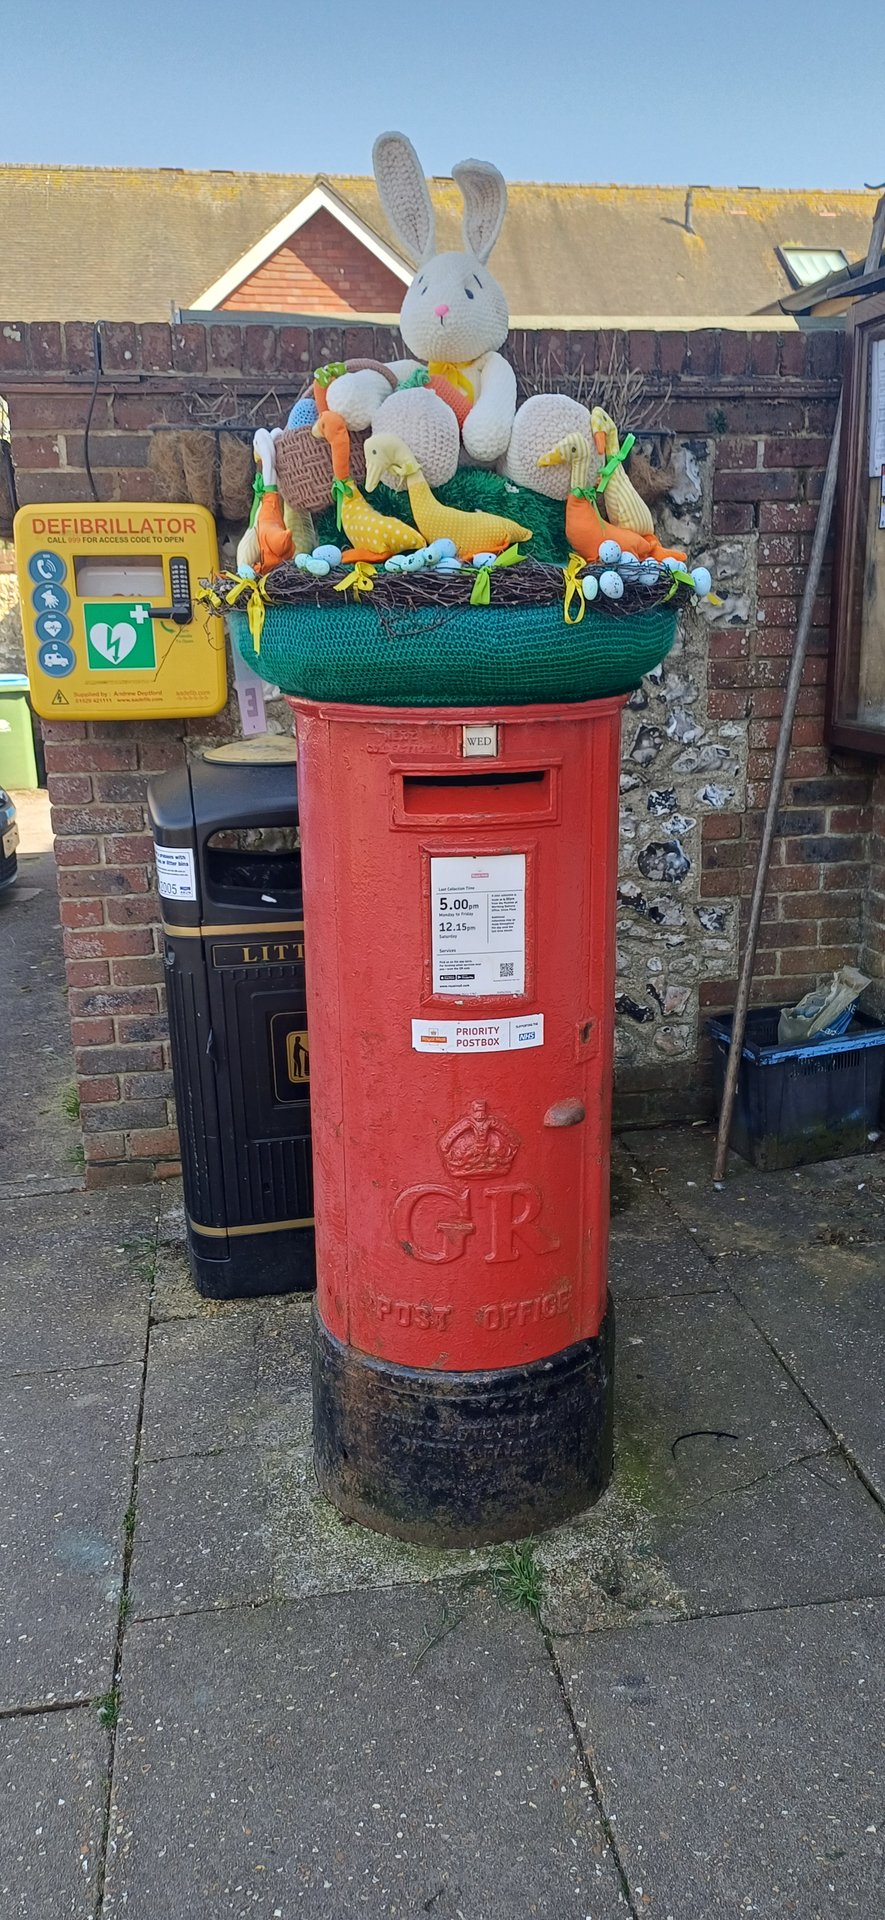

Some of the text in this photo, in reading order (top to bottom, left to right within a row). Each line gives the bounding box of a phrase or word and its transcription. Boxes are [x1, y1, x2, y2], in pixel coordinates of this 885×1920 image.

[32, 518, 196, 534] DEFIBRILLATOR
[467, 736, 492, 747] WED
[439, 897, 479, 911] 5.00pm
[439, 922, 476, 932] 12.15pm
[456, 1026, 500, 1036] PRIORITY
[456, 1038, 500, 1047] POSTBOX
[390, 1183, 561, 1265] GR
[373, 1285, 573, 1332] POST OFFICE
